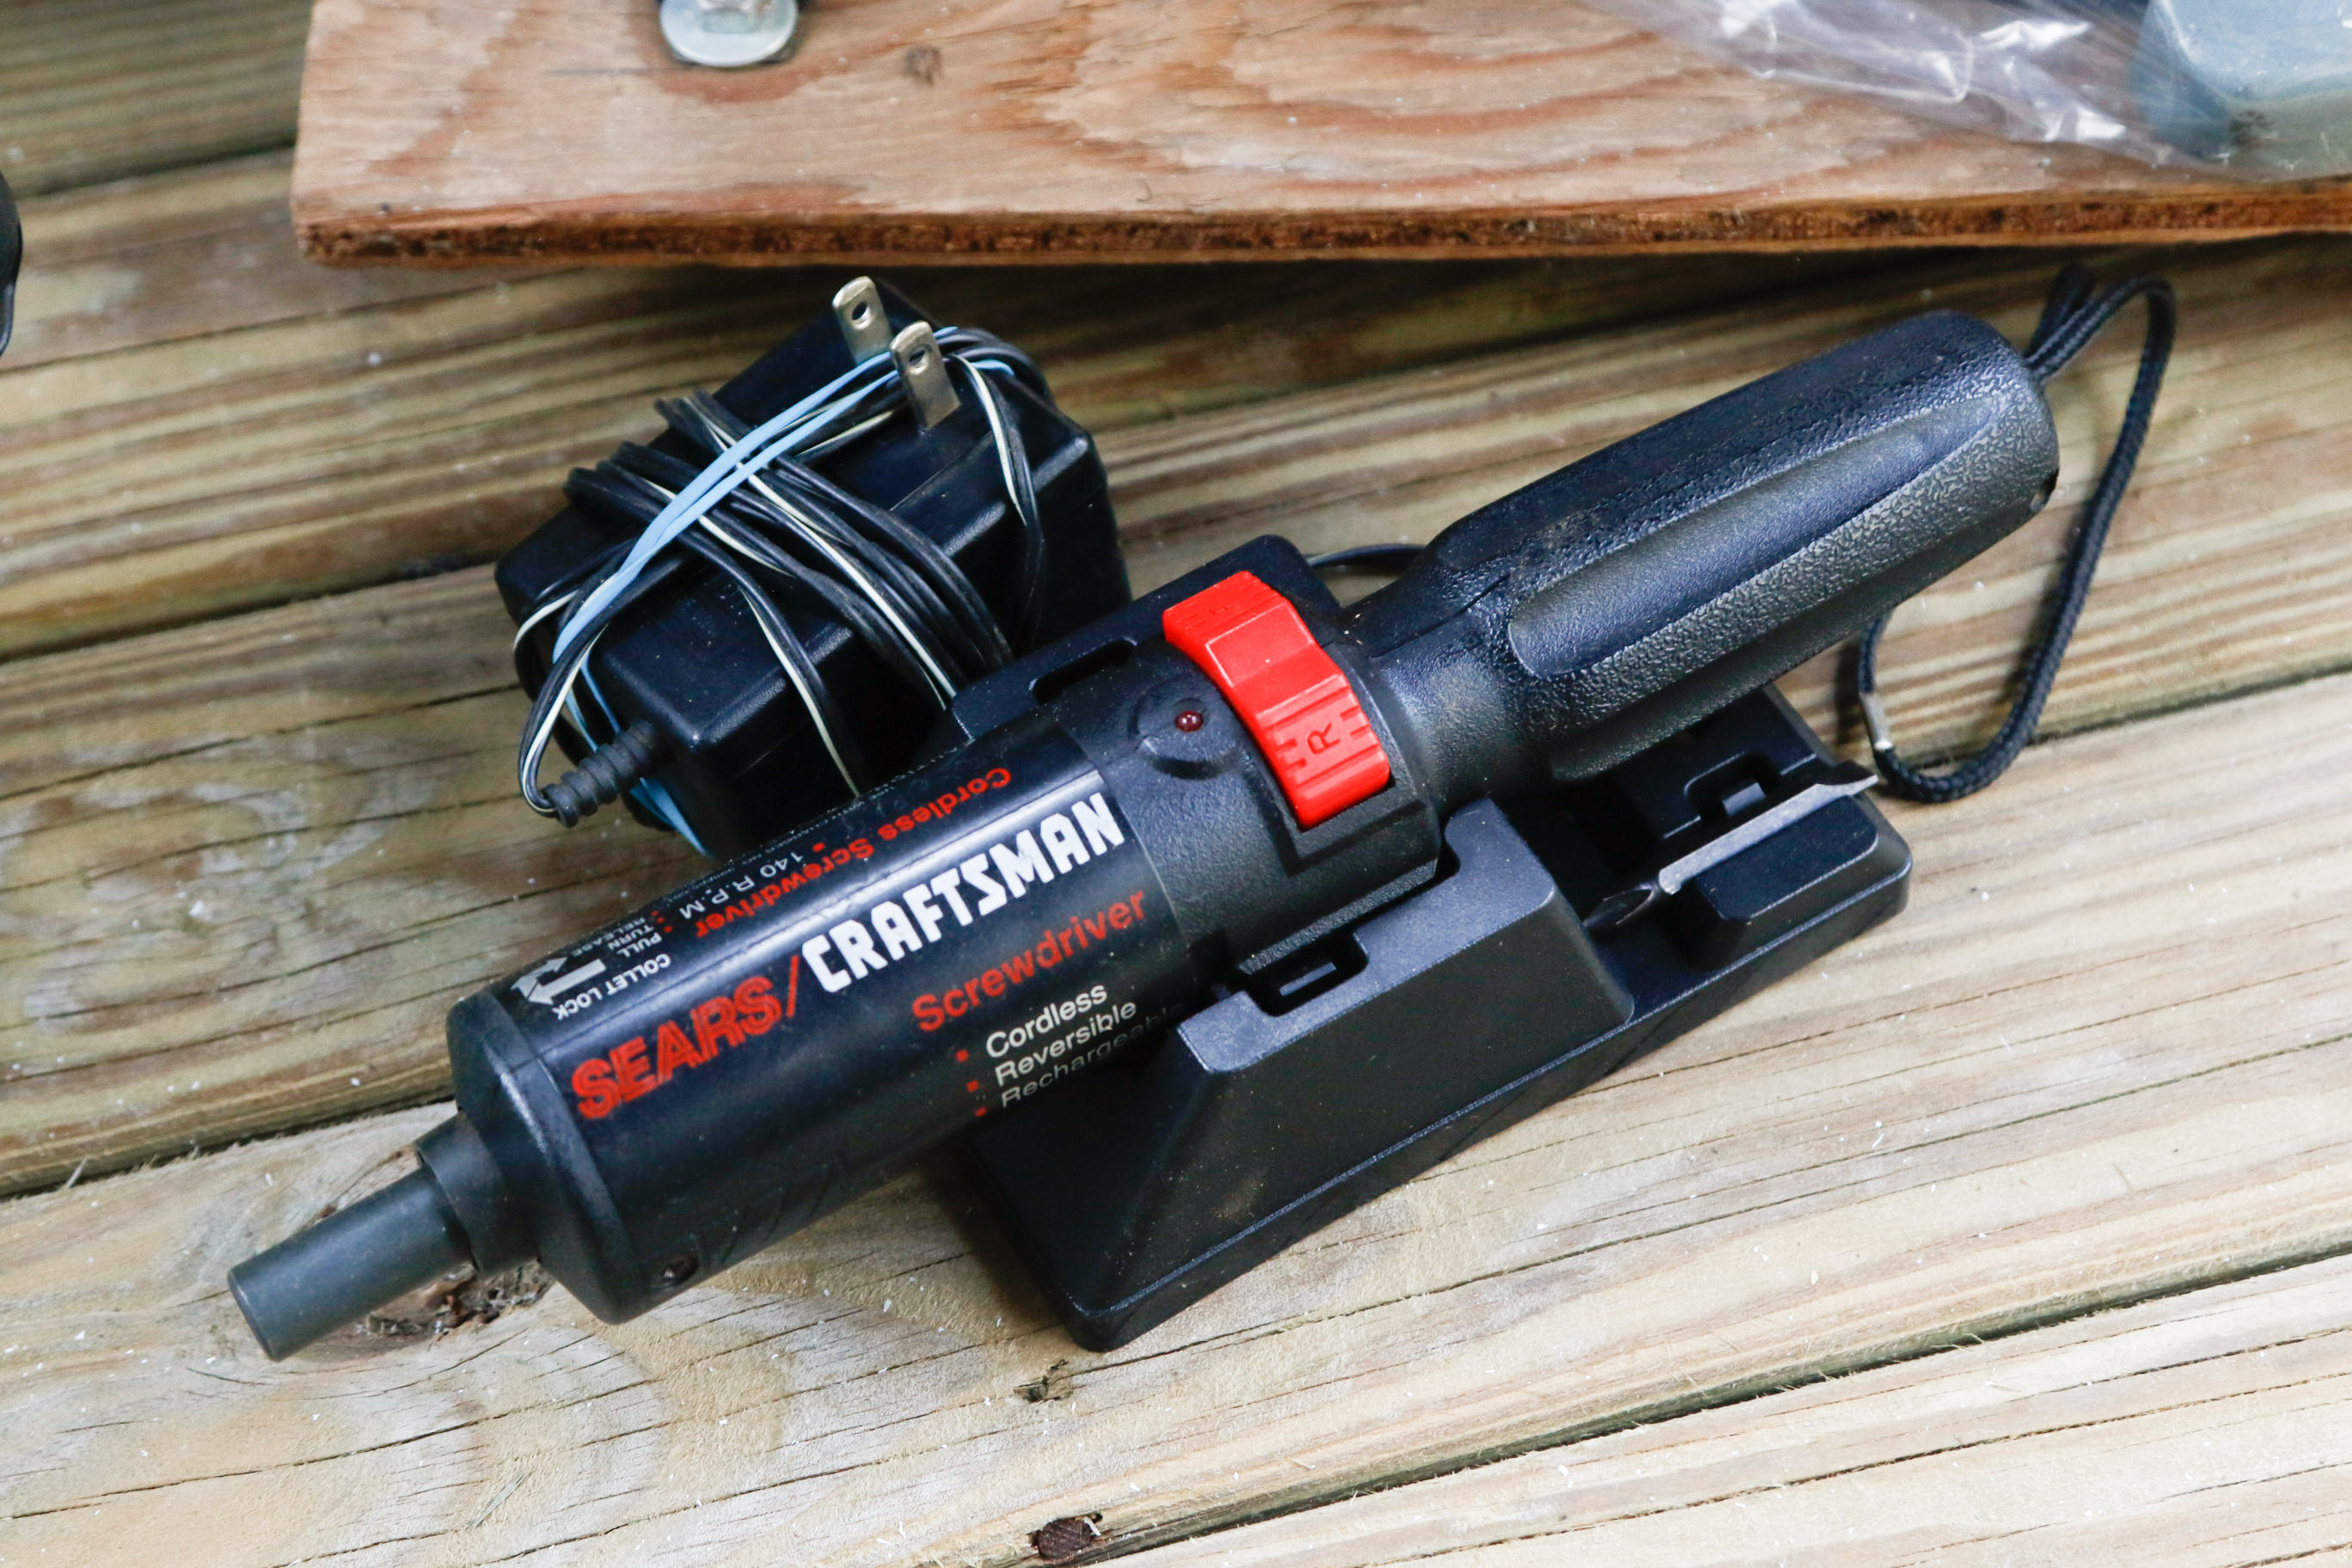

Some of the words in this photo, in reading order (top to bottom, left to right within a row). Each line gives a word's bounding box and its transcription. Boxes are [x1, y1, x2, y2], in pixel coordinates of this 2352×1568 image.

[1307, 722, 1340, 756] R
[877, 768, 1011, 841] Cordless
[695, 837, 874, 938] Screwdriver
[759, 852, 804, 879] 140
[802, 792, 1124, 993] CRAFTSMAN
[608, 924, 654, 951] TURN
[616, 932, 662, 958] PULL
[912, 891, 1144, 1031] Screwdriver
[605, 952, 671, 995] COLLET
[552, 987, 603, 1020] LOCK
[986, 984, 1107, 1058] Cordless
[995, 1001, 1136, 1087] Reversible
